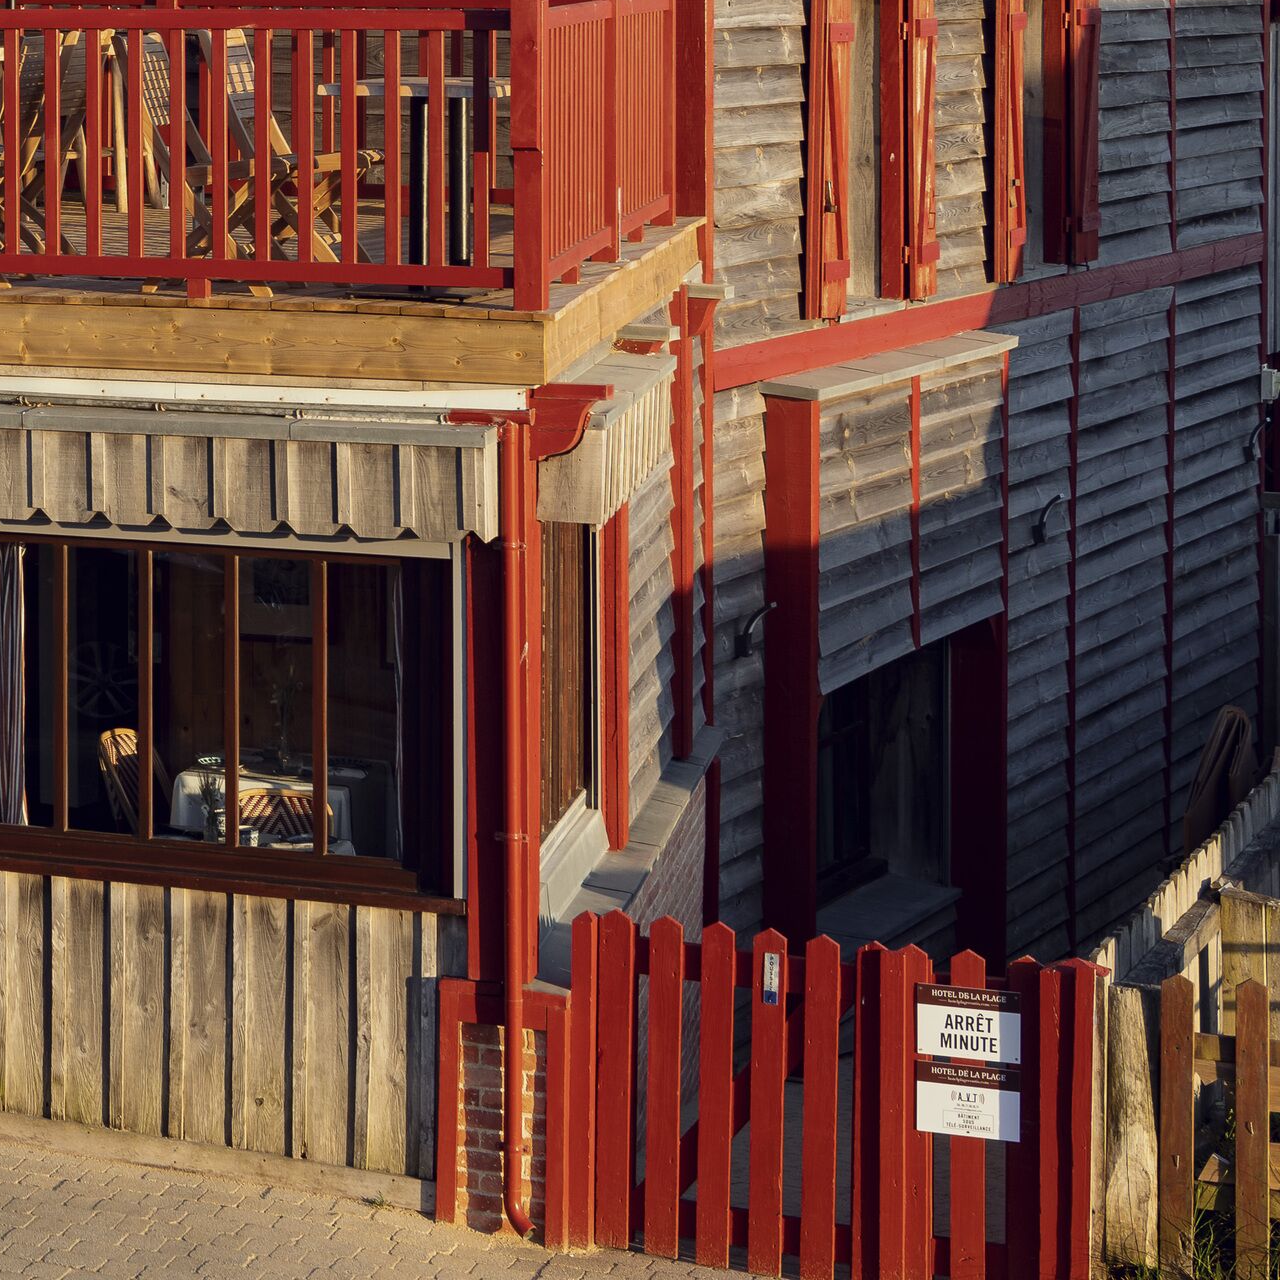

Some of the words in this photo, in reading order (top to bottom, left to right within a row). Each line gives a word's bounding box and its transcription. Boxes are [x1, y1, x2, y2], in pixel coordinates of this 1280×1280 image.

[931, 989, 957, 999] HOTEL
[970, 992, 981, 1001] LA
[981, 993, 1007, 1003] PLAGE
[944, 1013, 994, 1034] ARRÊT
[940, 1032, 998, 1054] MINUTE
[931, 1066, 957, 1077] HOTEL
[970, 1070, 981, 1080] LA
[981, 1071, 1007, 1082] PLAGE
